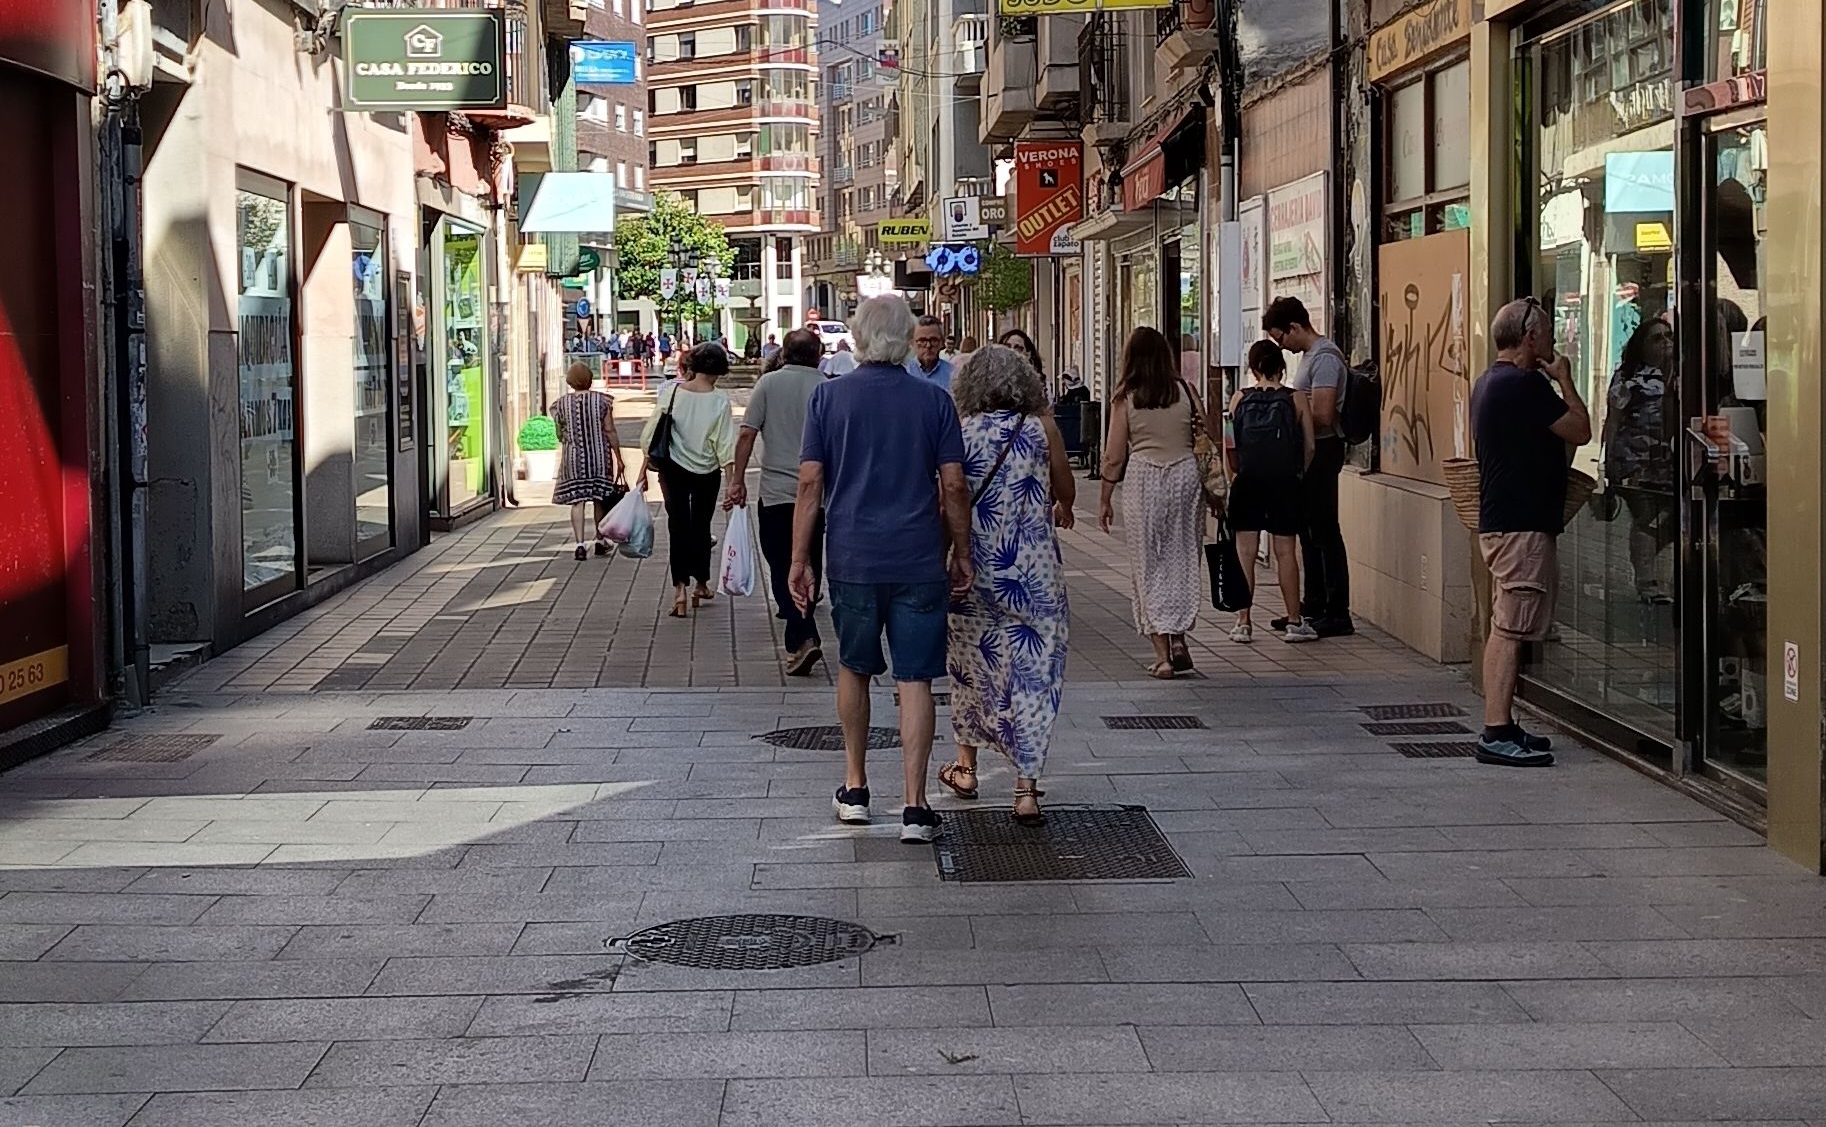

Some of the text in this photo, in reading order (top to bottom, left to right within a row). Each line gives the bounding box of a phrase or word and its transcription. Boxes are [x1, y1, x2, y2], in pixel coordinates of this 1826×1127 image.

[356, 62, 494, 76] CASA FEDERICO
[1018, 147, 1080, 163] VERONA
[1023, 157, 1078, 170] SHOES
[981, 207, 1006, 220] ORO
[1019, 188, 1080, 239] OUTLET
[881, 224, 930, 236] RUBEN
[1053, 233, 1068, 242] club
[1053, 241, 1080, 249] zapato
[8, 668, 25, 691] 25
[28, 662, 44, 684] 63
